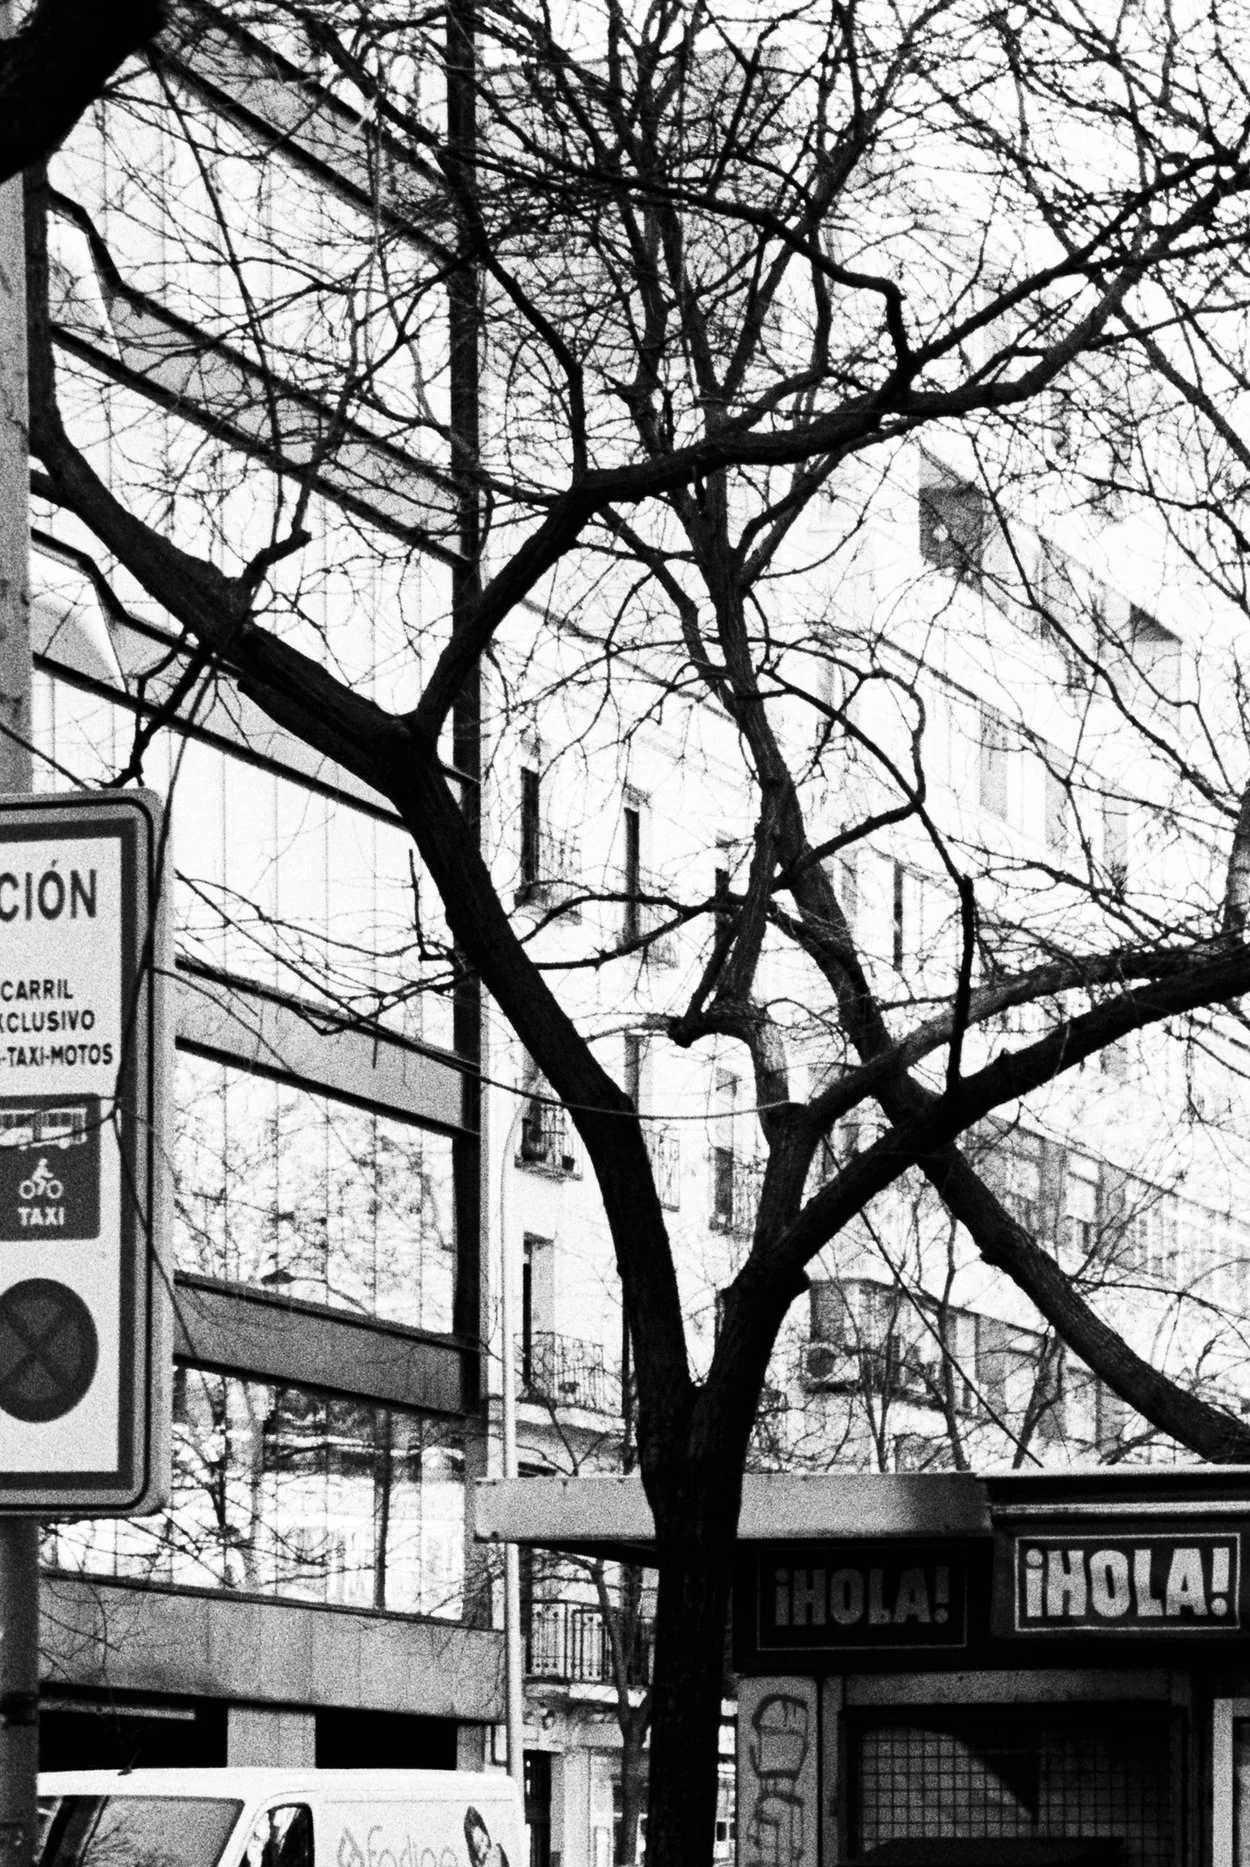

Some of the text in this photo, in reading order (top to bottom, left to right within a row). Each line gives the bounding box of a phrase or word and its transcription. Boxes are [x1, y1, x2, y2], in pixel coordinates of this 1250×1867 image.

[0, 979, 74, 1001] CARRIL
[17, 1206, 65, 1226] TAXI
[775, 1566, 949, 1625] ¡HOLA!
[1026, 1547, 1230, 1617] ¡HOLA!
